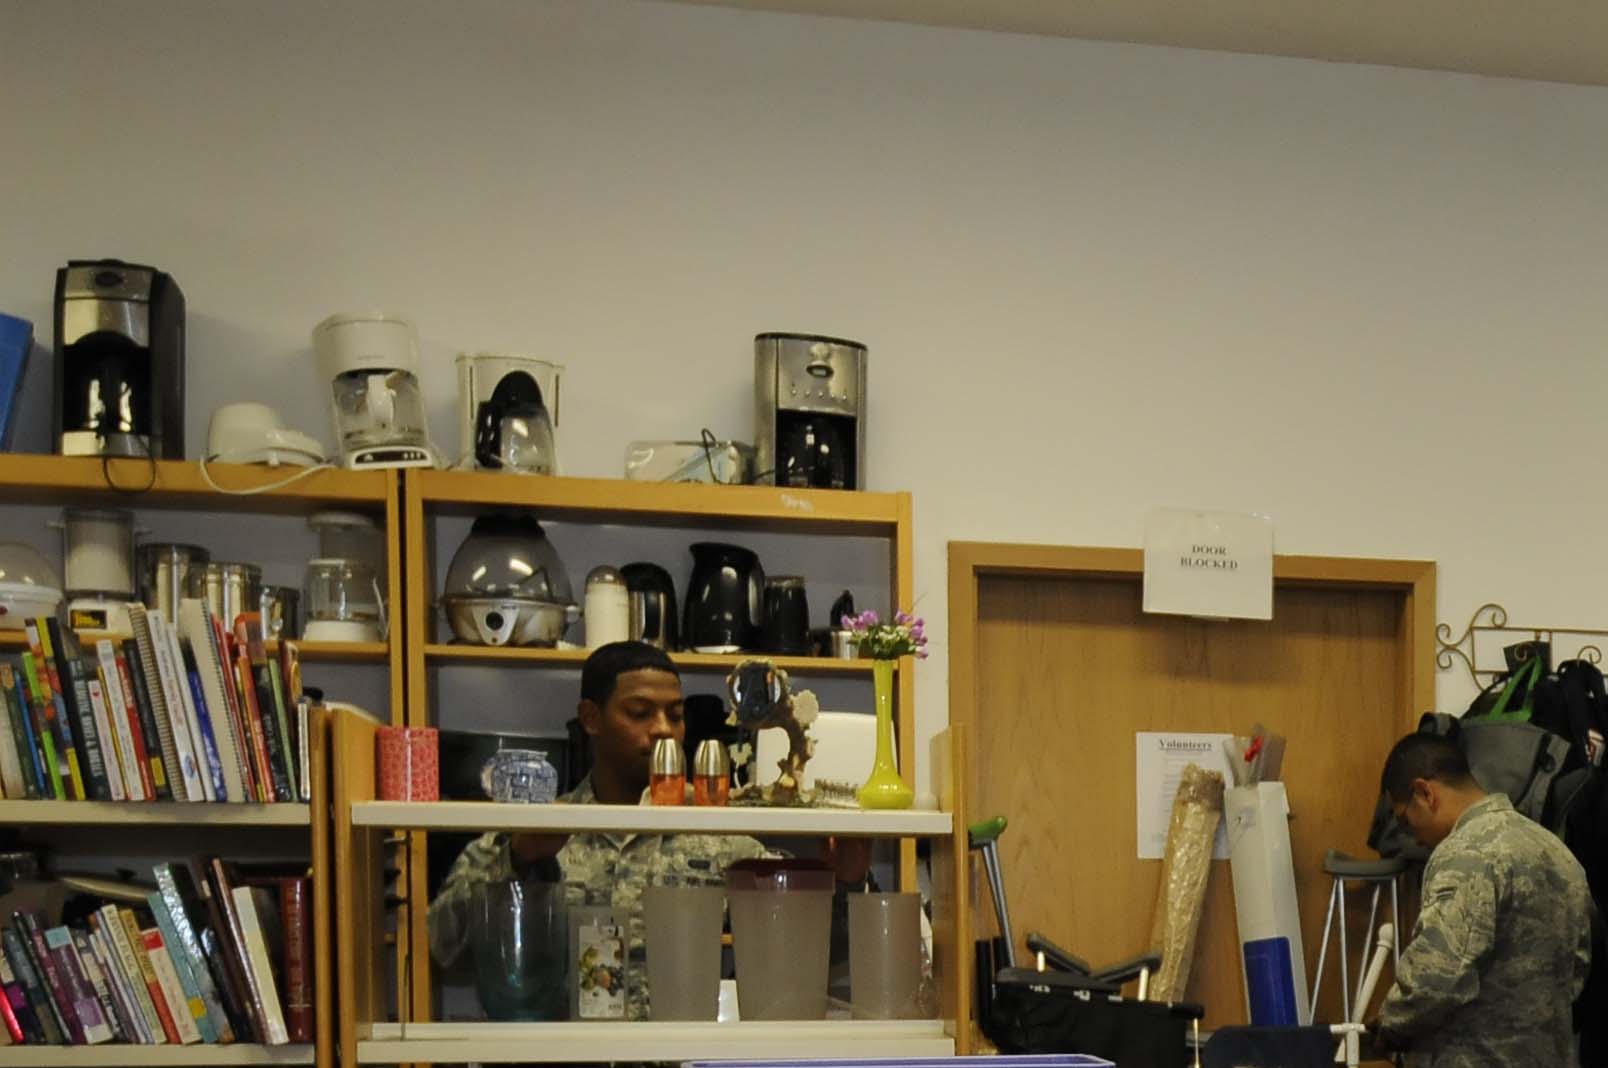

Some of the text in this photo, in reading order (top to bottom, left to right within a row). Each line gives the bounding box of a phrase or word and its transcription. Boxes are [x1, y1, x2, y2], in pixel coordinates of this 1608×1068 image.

[1192, 545, 1226, 556] DOOR
[1180, 556, 1238, 569] BLOCKED
[1159, 739, 1213, 751] Volunteers
